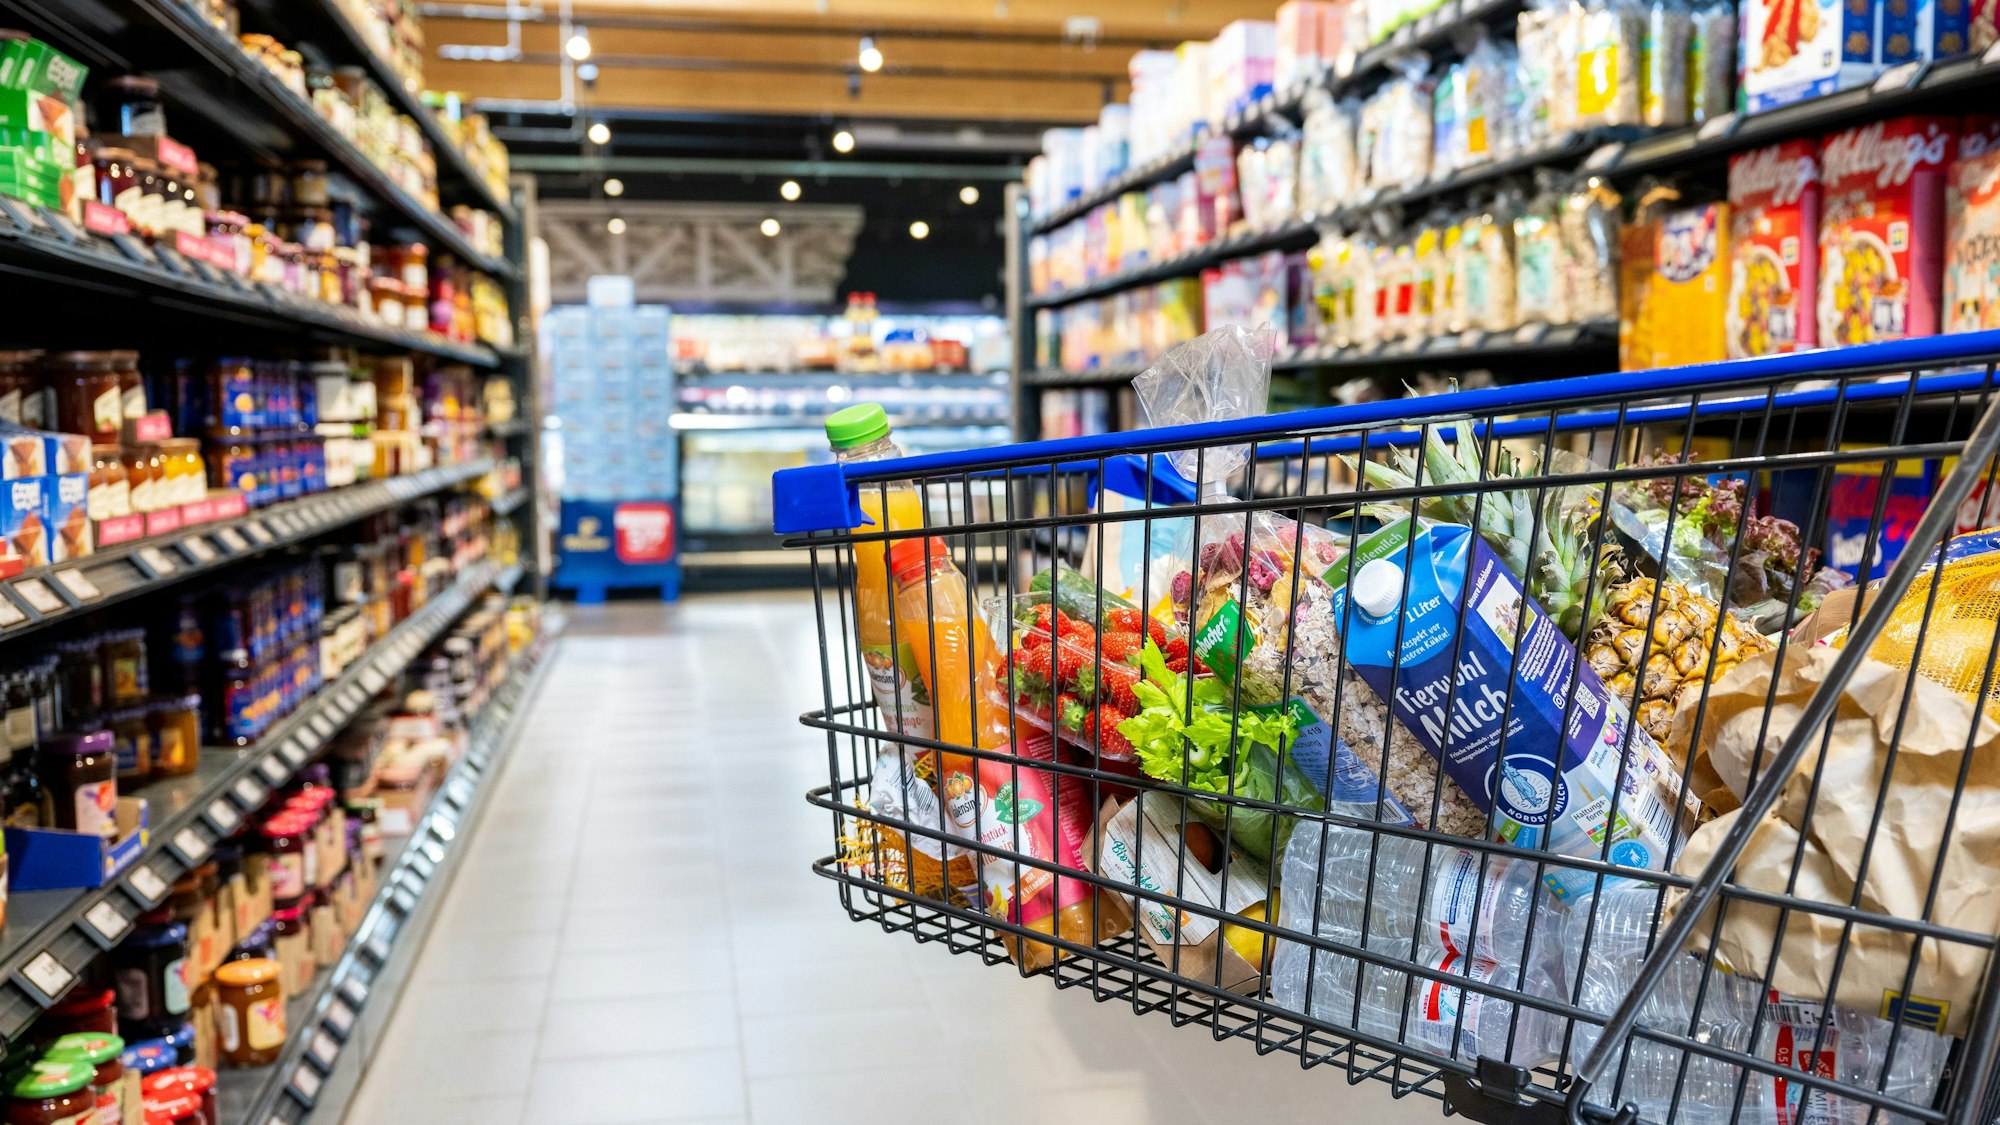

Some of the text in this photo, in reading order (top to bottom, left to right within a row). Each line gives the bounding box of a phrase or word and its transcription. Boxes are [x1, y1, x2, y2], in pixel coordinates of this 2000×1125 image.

[1727, 143, 1819, 207] Kellogg
[1604, 529, 1630, 570] EDKA
[1405, 612, 1415, 623] 1
[1415, 595, 1441, 619] Liter
[1424, 627, 1451, 650] Kühen!
[1428, 623, 1441, 635] vor
[1395, 650, 1488, 714] Tierwohl
[1420, 684, 1515, 749] Milch
[1307, 727, 1322, 736] 419
[997, 784, 1012, 802] 100%
[1553, 783, 1566, 812] MILCH
[1010, 803, 1029, 814] one
[1574, 799, 1606, 821] Haltungs-
[1586, 810, 1605, 822] form
[1025, 872, 1035, 884] mit
[1777, 1047, 1790, 1063] 0,5
